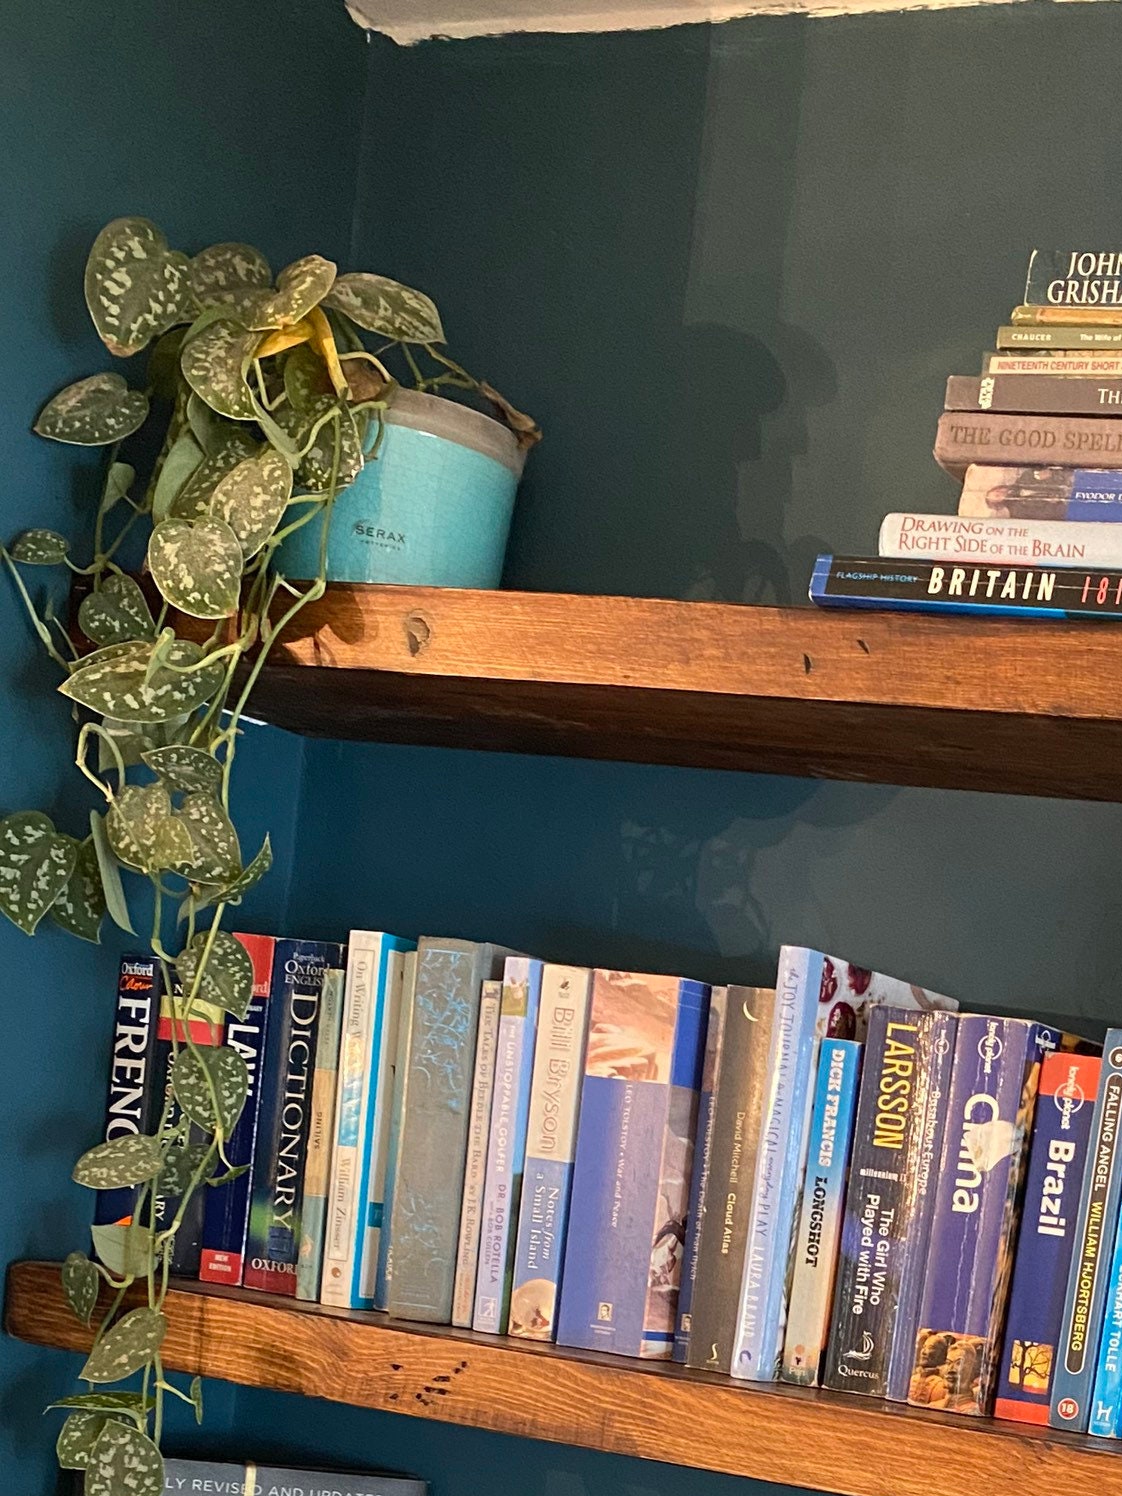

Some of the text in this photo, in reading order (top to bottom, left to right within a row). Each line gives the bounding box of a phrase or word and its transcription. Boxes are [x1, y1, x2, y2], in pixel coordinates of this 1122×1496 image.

[998, 360, 1049, 371] NINETEENTH
[1050, 361, 1089, 371] CENTURY
[1091, 361, 1119, 371] SHORT
[951, 425, 991, 445] THE
[999, 427, 1056, 448] GOOD
[355, 524, 406, 544] SERAX
[899, 533, 1086, 558] RIGHT SIDE OF THE BRAIN
[901, 517, 1029, 537] DRAWING ON THE
[927, 567, 1056, 601] BRITAIN
[272, 990, 319, 1231] DICTIONARY
[539, 1007, 575, 1155] Bill Bryson
[818, 1048, 846, 1168] DICK FRANCIS
[872, 1022, 918, 1150] LARSSON
[313, 1111, 323, 1150] SAILING
[721, 1111, 746, 1255] David Mitchell Cloud Atlas
[805, 1176, 828, 1268] LONGSHOT
[1037, 1139, 1076, 1237] Brazil
[1071, 1085, 1120, 1352] FALLING ANGEL WILLIAM HJORTSBERG
[852, 1193, 881, 1315] Played with Fire
[869, 1208, 894, 1306] The Girl Who
[837, 1364, 880, 1380] Quercus
[1104, 1330, 1121, 1373] TOLLE
